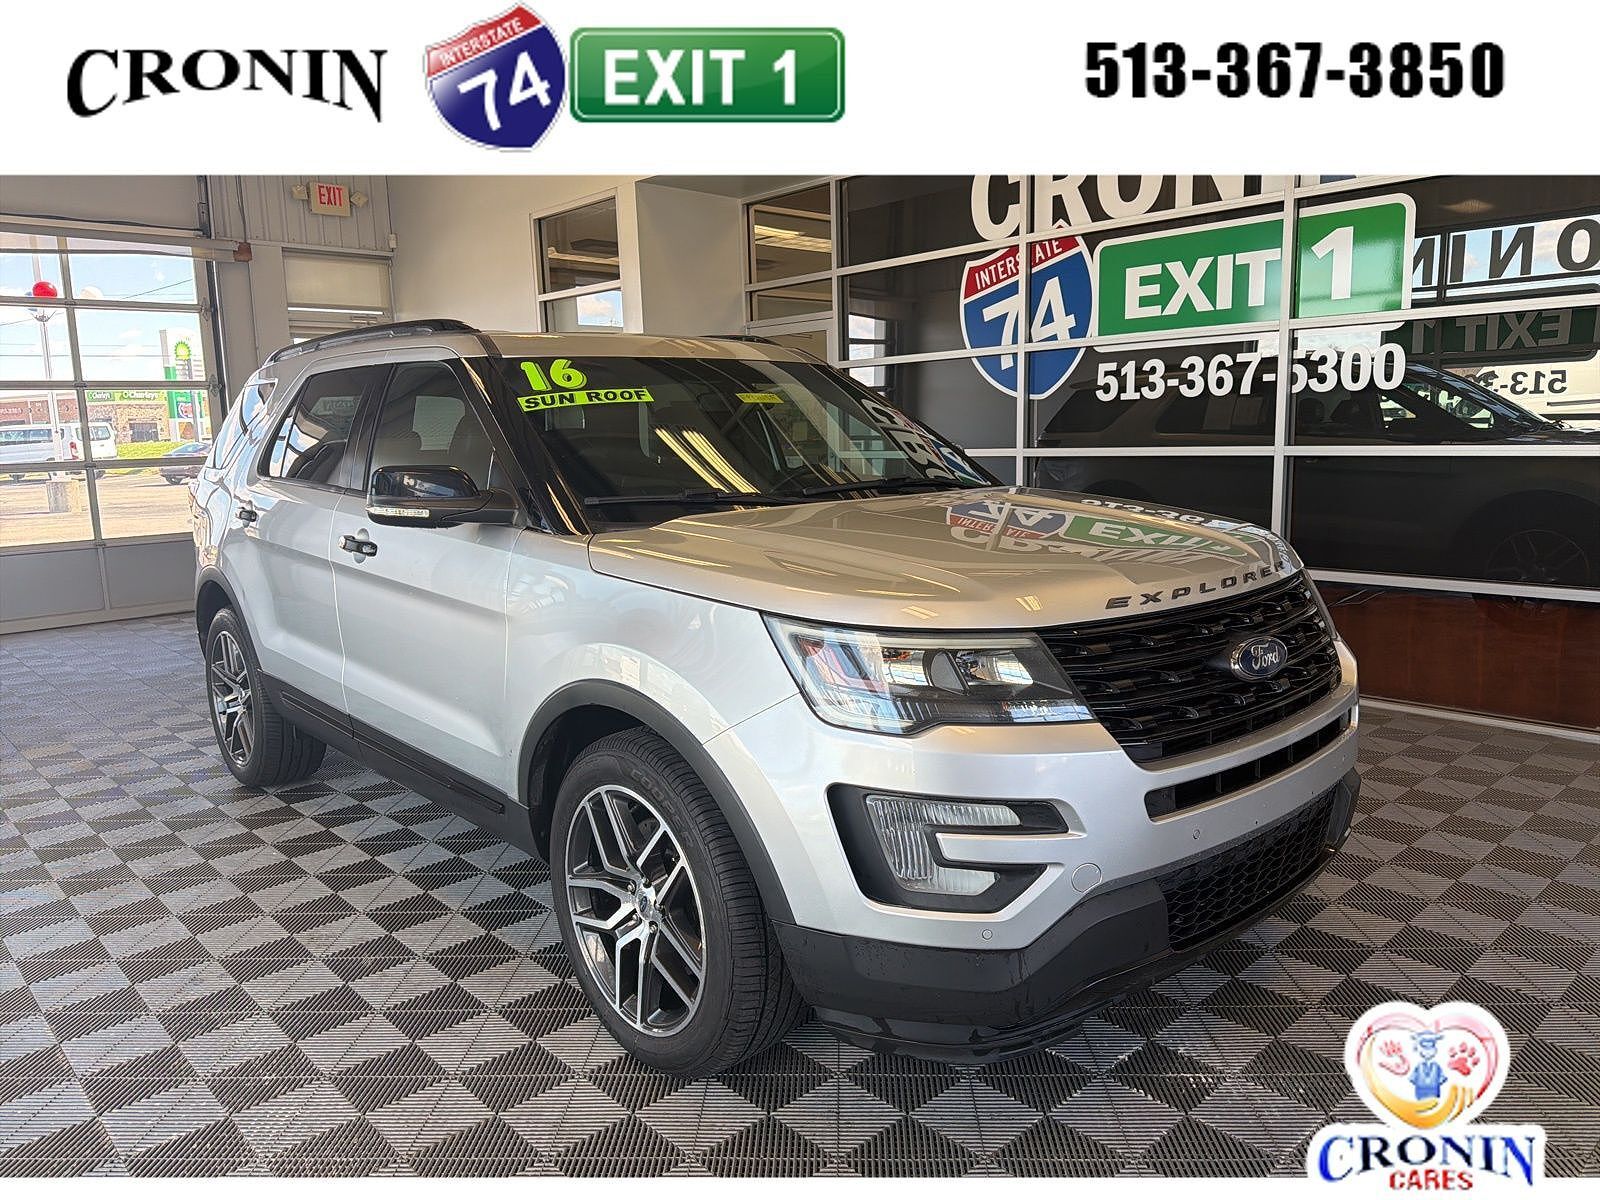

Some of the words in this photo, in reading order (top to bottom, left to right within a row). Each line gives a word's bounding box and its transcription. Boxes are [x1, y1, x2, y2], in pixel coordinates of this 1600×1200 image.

[317, 184, 343, 207] EXIT
[975, 239, 1063, 291] INTERATE
[1124, 247, 1282, 320] EXIT
[1311, 225, 1354, 301] 1
[982, 275, 1077, 371] 74
[520, 358, 588, 391] 16
[1095, 342, 1407, 403] 513-367-5300
[524, 393, 576, 409] SUN
[585, 389, 647, 402] ROOF
[1105, 560, 1286, 610] EXPLORER
[1250, 643, 1281, 670] Ford
